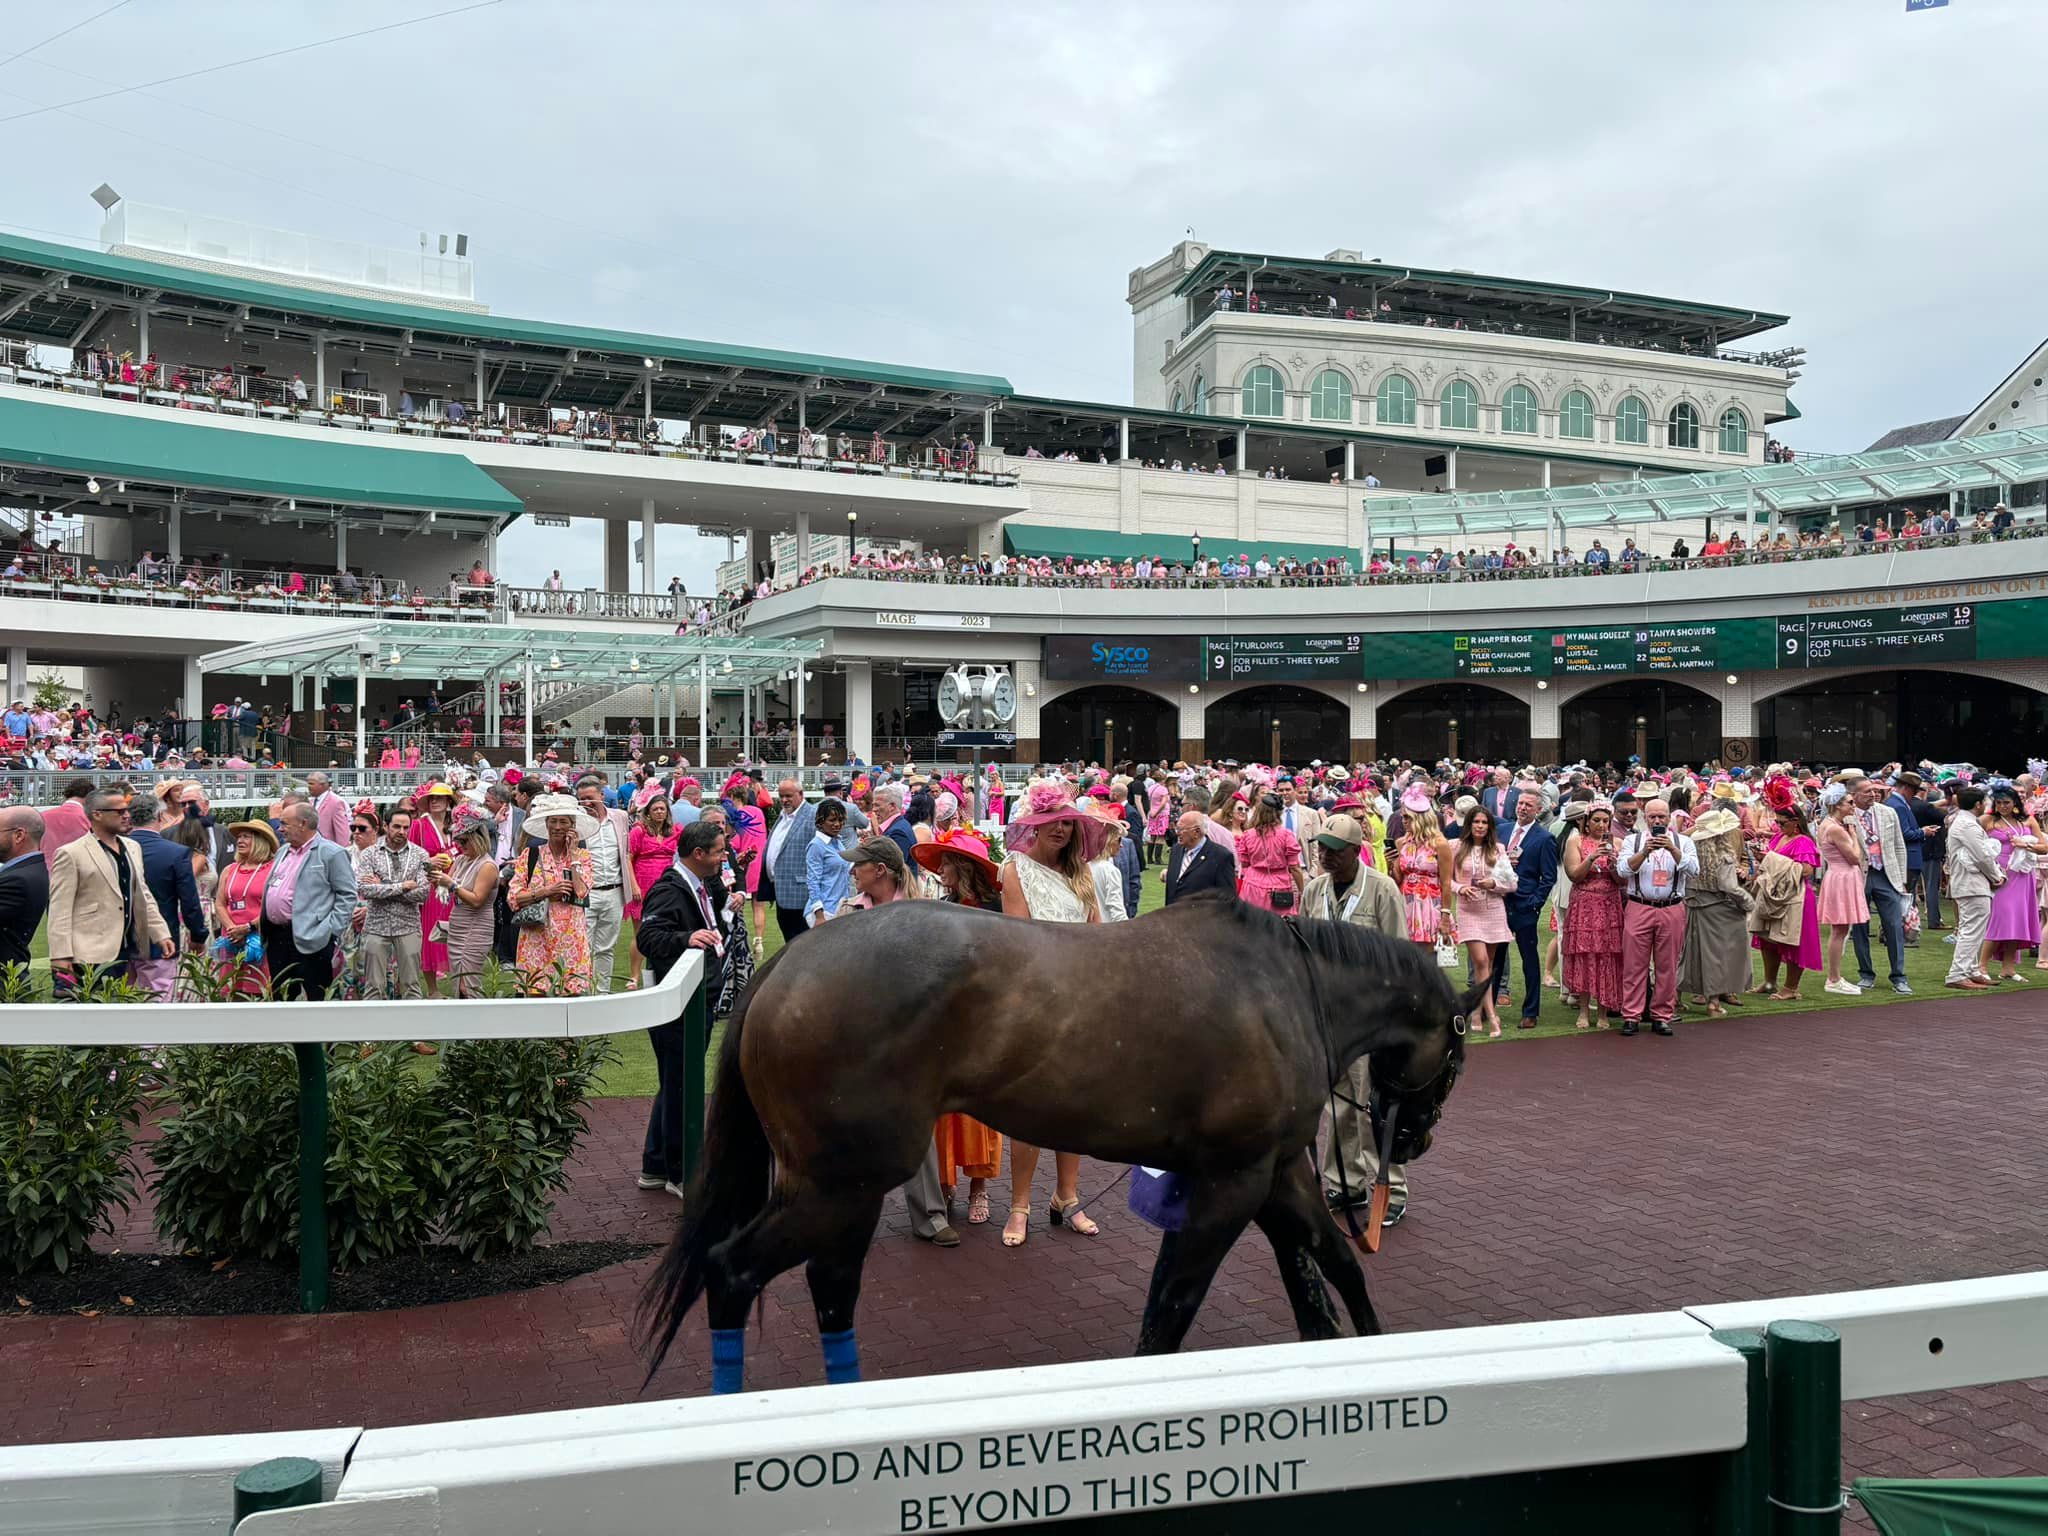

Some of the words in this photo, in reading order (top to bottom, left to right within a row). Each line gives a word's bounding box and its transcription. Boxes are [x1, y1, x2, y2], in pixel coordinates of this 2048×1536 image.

[1808, 591, 1896, 608] KENTUCKY
[1903, 584, 1960, 601] DERBY
[1965, 582, 2001, 596] RUN
[2007, 579, 2031, 592] ON
[1900, 611, 1948, 622] LONGINES
[1954, 607, 1971, 619] 19
[879, 613, 917, 624] MAGE
[961, 616, 984, 626] 2023
[1779, 623, 1806, 633] RACE
[1810, 622, 1817, 631] 7
[1817, 619, 1873, 630] FURLONGS
[1566, 633, 1577, 641] MY
[1577, 632, 1598, 640] MANE
[1599, 631, 1631, 640] SQUEEZE
[1636, 632, 1647, 642] 10
[1649, 629, 1676, 638] TANYA
[1676, 627, 1716, 637] SHOWERS
[1347, 636, 1360, 646] 19
[1478, 636, 1510, 644] HARPER
[1511, 635, 1533, 643] ROSE
[1809, 640, 1830, 649] FOR
[1832, 638, 1867, 648] FILLIES
[1876, 635, 1910, 645] THREE
[1912, 633, 1944, 643] YEARS
[1209, 642, 1230, 650] RACE
[1240, 641, 1284, 650] FURLONGS
[1785, 638, 1798, 655] 9
[1809, 649, 1832, 658] OLD
[1214, 655, 1225, 669] 9
[1233, 657, 1250, 665] FOR
[1252, 657, 1279, 665] FILLIES
[1286, 656, 1313, 665] THREE
[1314, 656, 1340, 664] YEARS
[1458, 659, 1464, 667] 9
[1679, 660, 1714, 668] HARTMAN
[1233, 665, 1252, 673] OLD
[1566, 664, 1596, 672] MICHAEL
[734, 1451, 859, 1495] FOOD
[873, 1441, 963, 1480] AND
[980, 1416, 1206, 1469] BEVERAGES
[1220, 1395, 1448, 1446] PROHIBITED
[901, 1484, 1071, 1532] BEYOND
[1082, 1472, 1171, 1511] THIS
[1186, 1459, 1306, 1501] POINT
